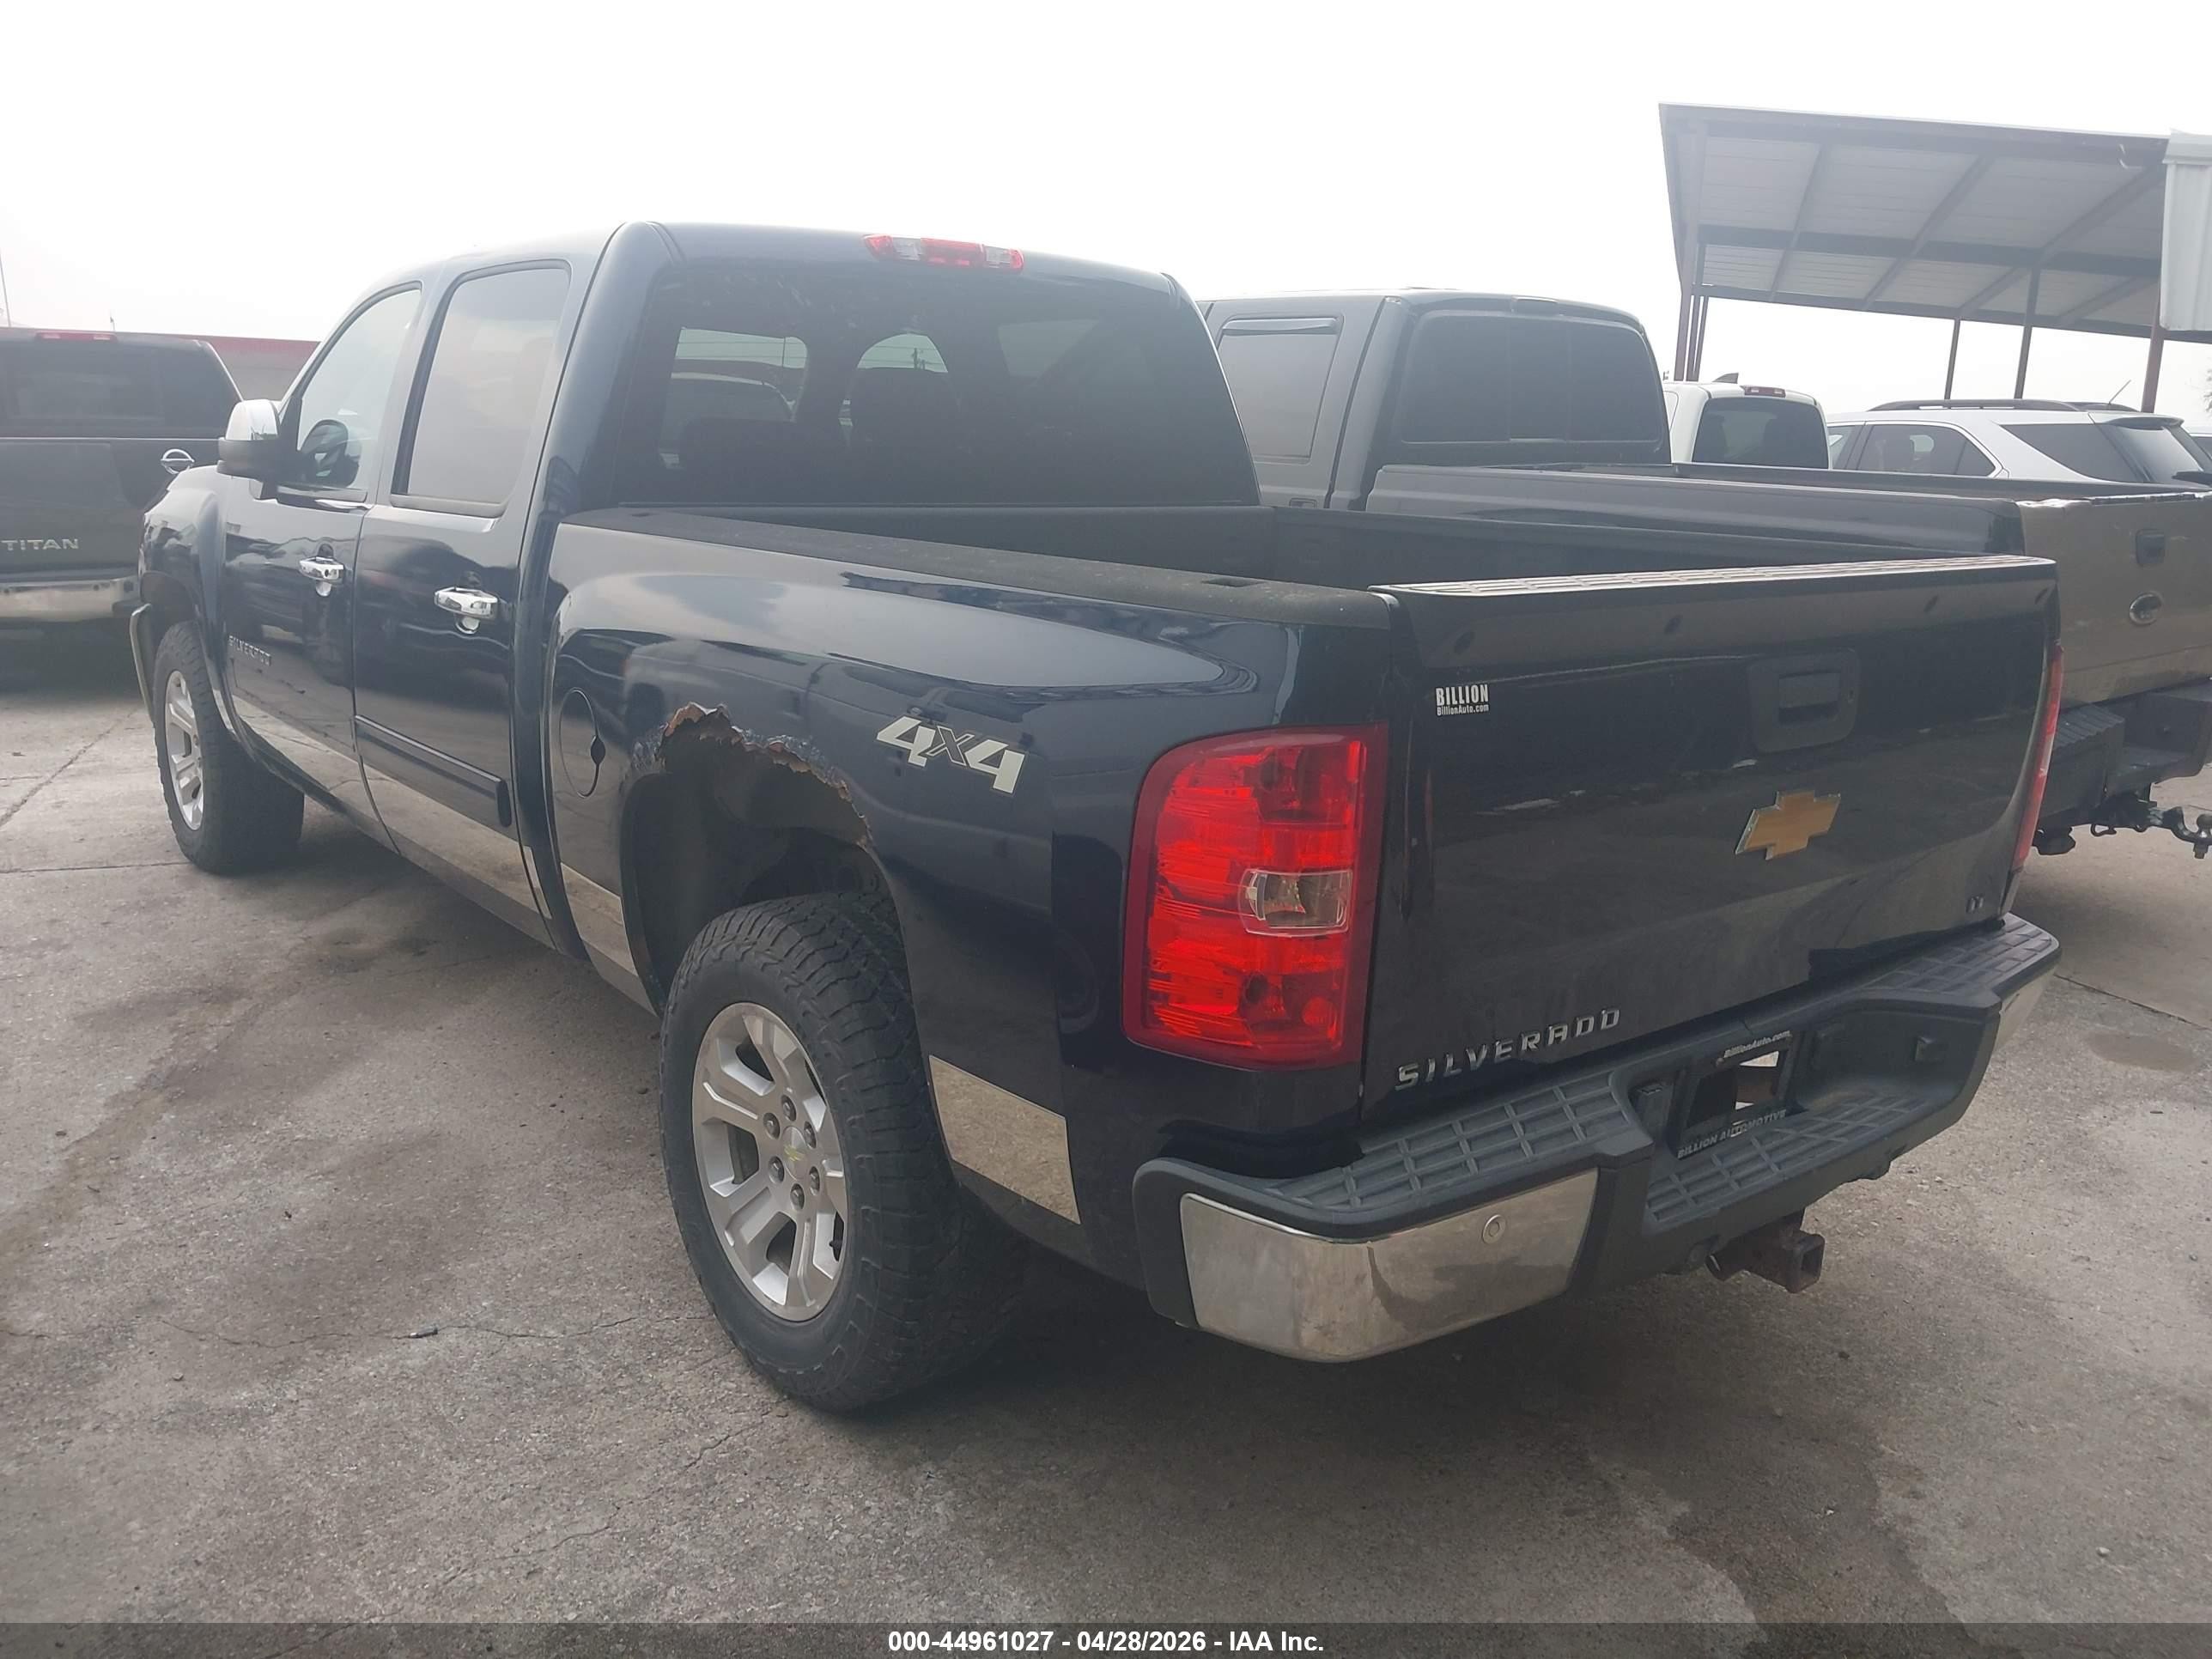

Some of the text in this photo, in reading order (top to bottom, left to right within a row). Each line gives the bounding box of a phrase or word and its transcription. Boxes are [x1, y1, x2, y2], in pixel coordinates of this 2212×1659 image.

[1, 538, 79, 550] TITAN
[1436, 684, 1489, 706] BILLION
[1437, 704, 1490, 716] BillionAuto.com
[1395, 1008, 1620, 1091] SILVERADO
[1677, 1109, 1788, 1159] BILLION AUTOMOTIVE
